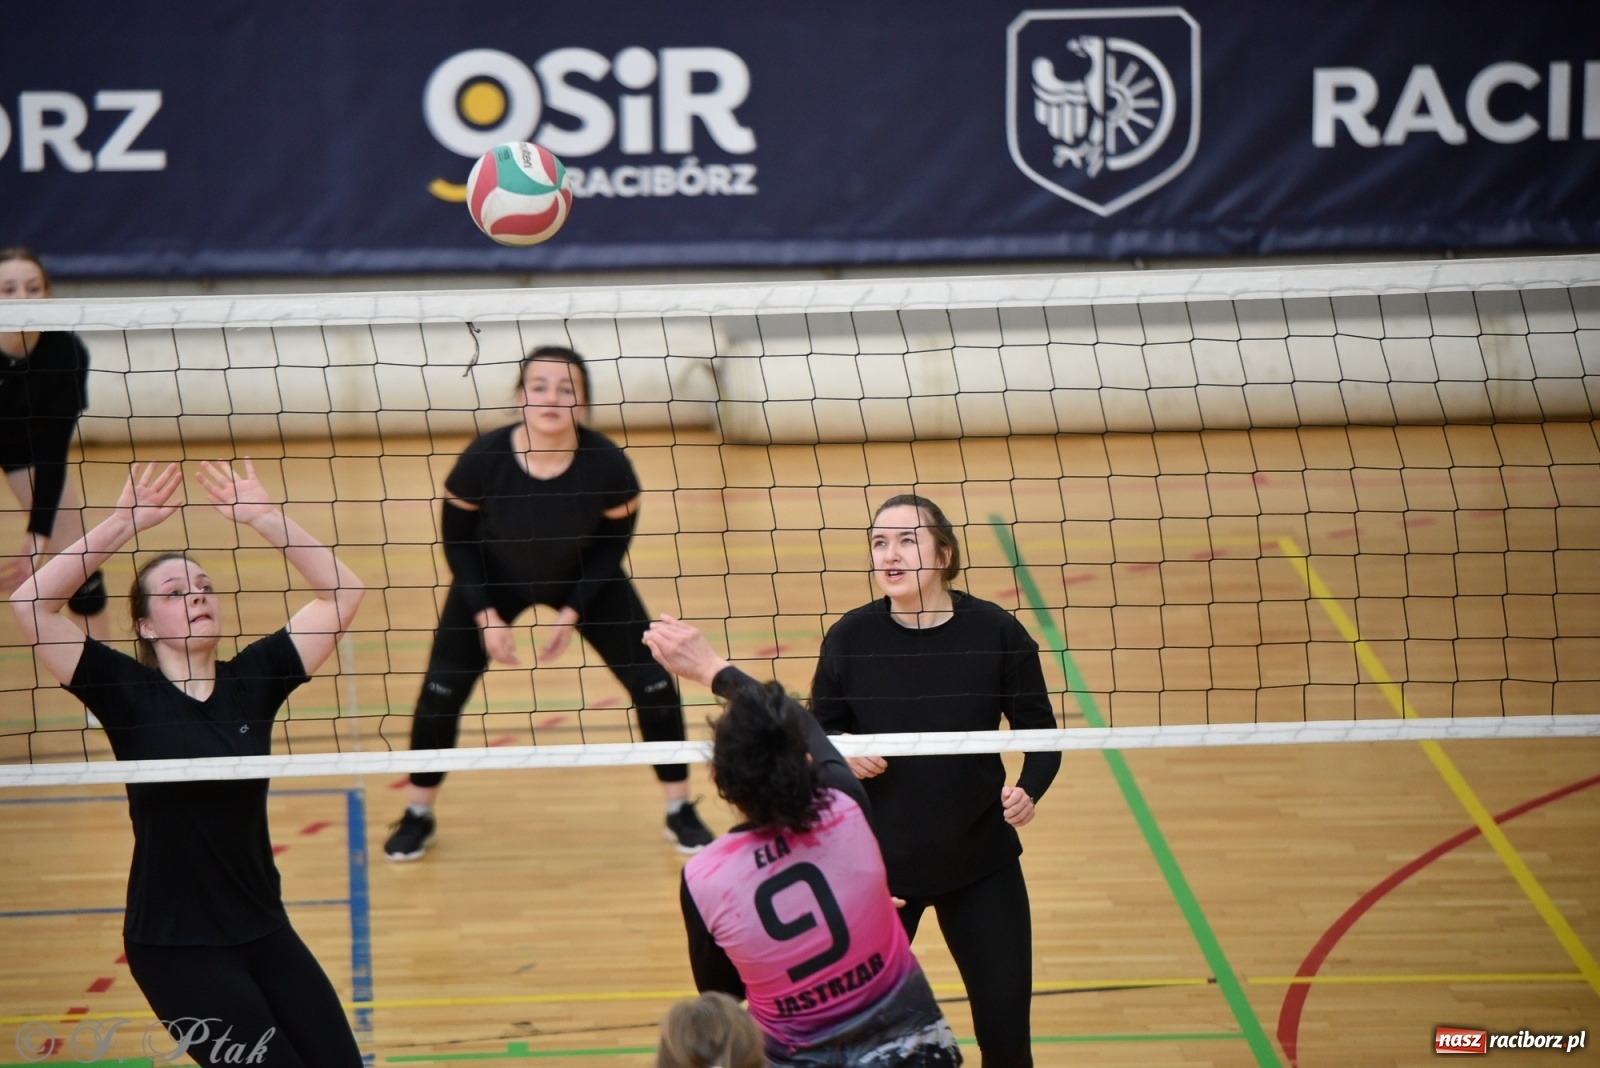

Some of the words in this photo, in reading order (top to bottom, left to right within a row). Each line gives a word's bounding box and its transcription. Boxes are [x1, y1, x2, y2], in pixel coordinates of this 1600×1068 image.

[0, 90, 167, 173] RZ
[423, 46, 757, 158] OSiR
[1312, 60, 1600, 148] RACI
[754, 834, 792, 869] ELA
[754, 861, 850, 984] 9
